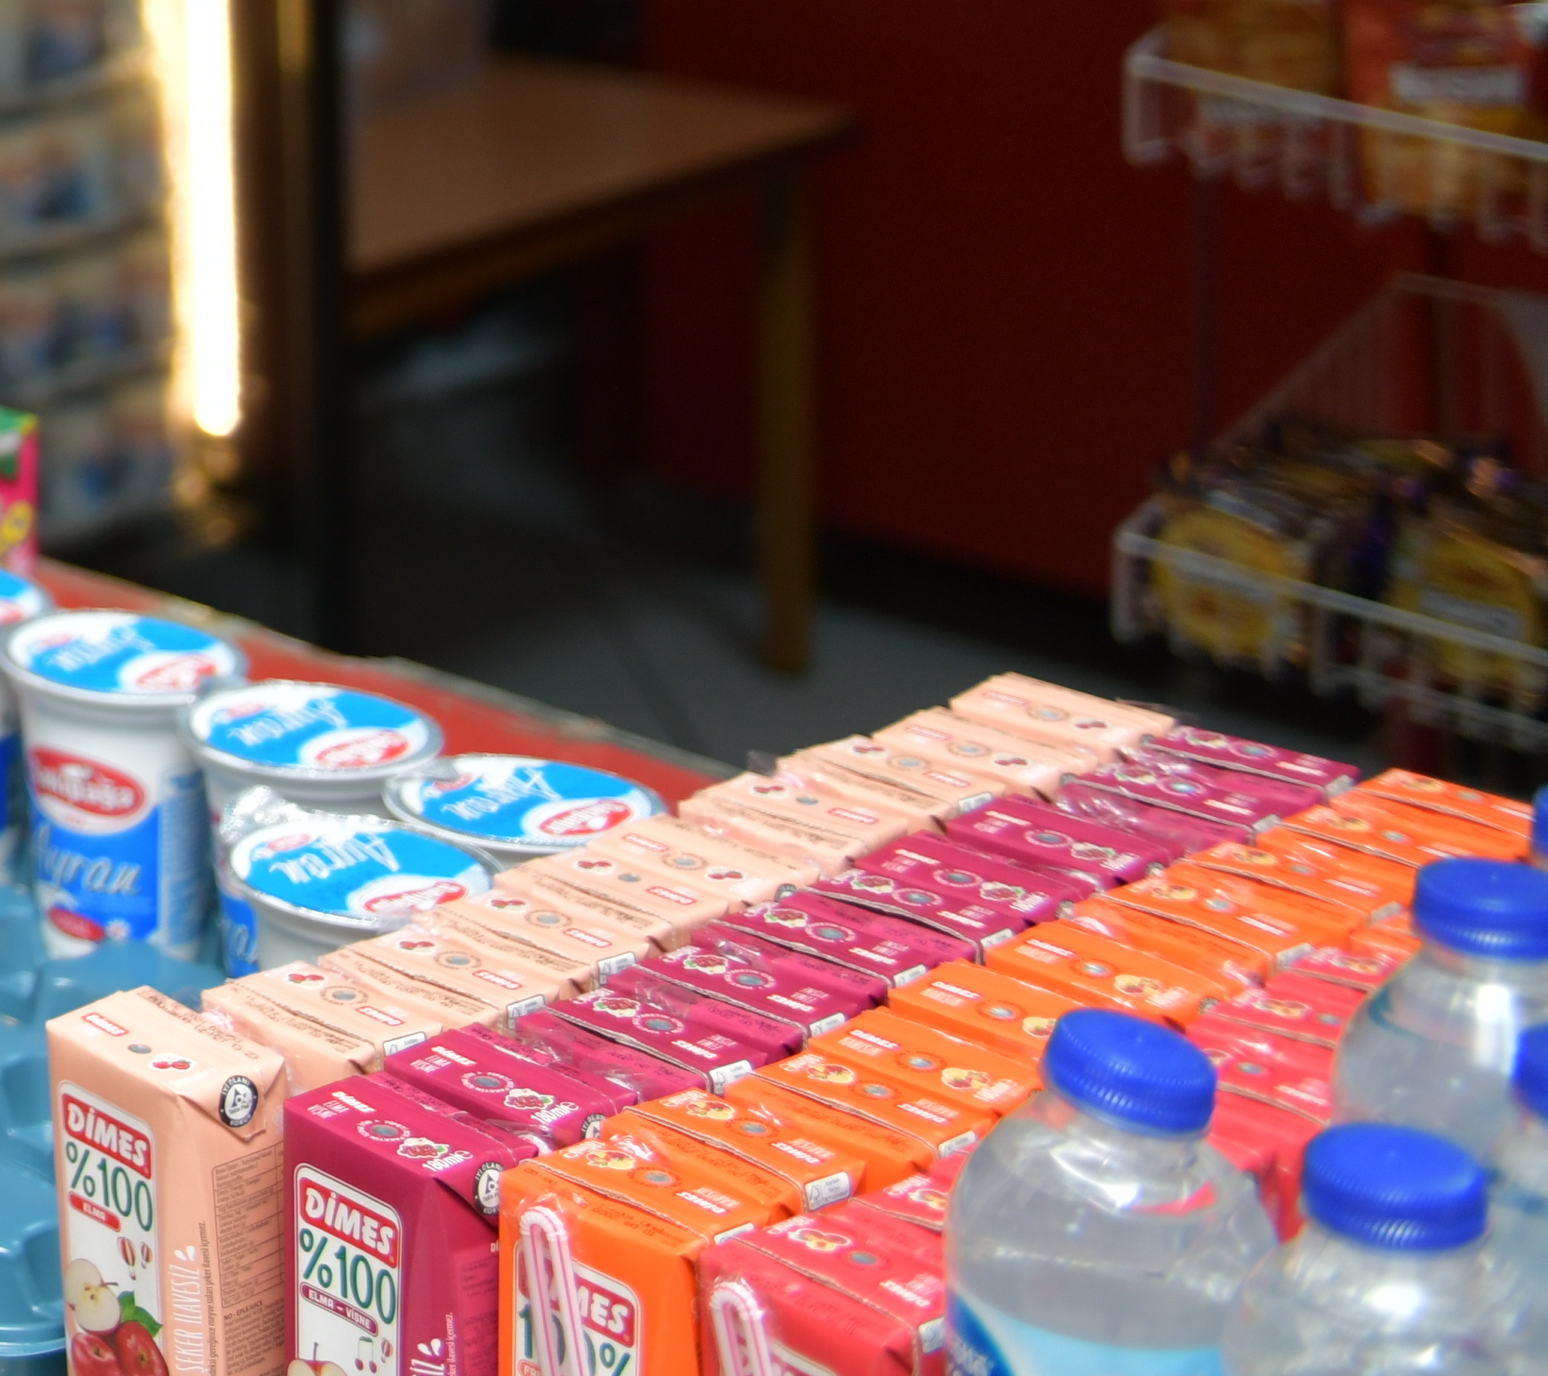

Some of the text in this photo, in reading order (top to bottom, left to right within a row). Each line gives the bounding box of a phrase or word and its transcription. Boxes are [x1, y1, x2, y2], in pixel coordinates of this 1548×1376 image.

[67, 1102, 147, 1167] DİMES
[65, 1141, 153, 1232] %100
[305, 1187, 394, 1255] DİMES
[300, 1228, 396, 1325] %100
[308, 1288, 334, 1309] ELMA
